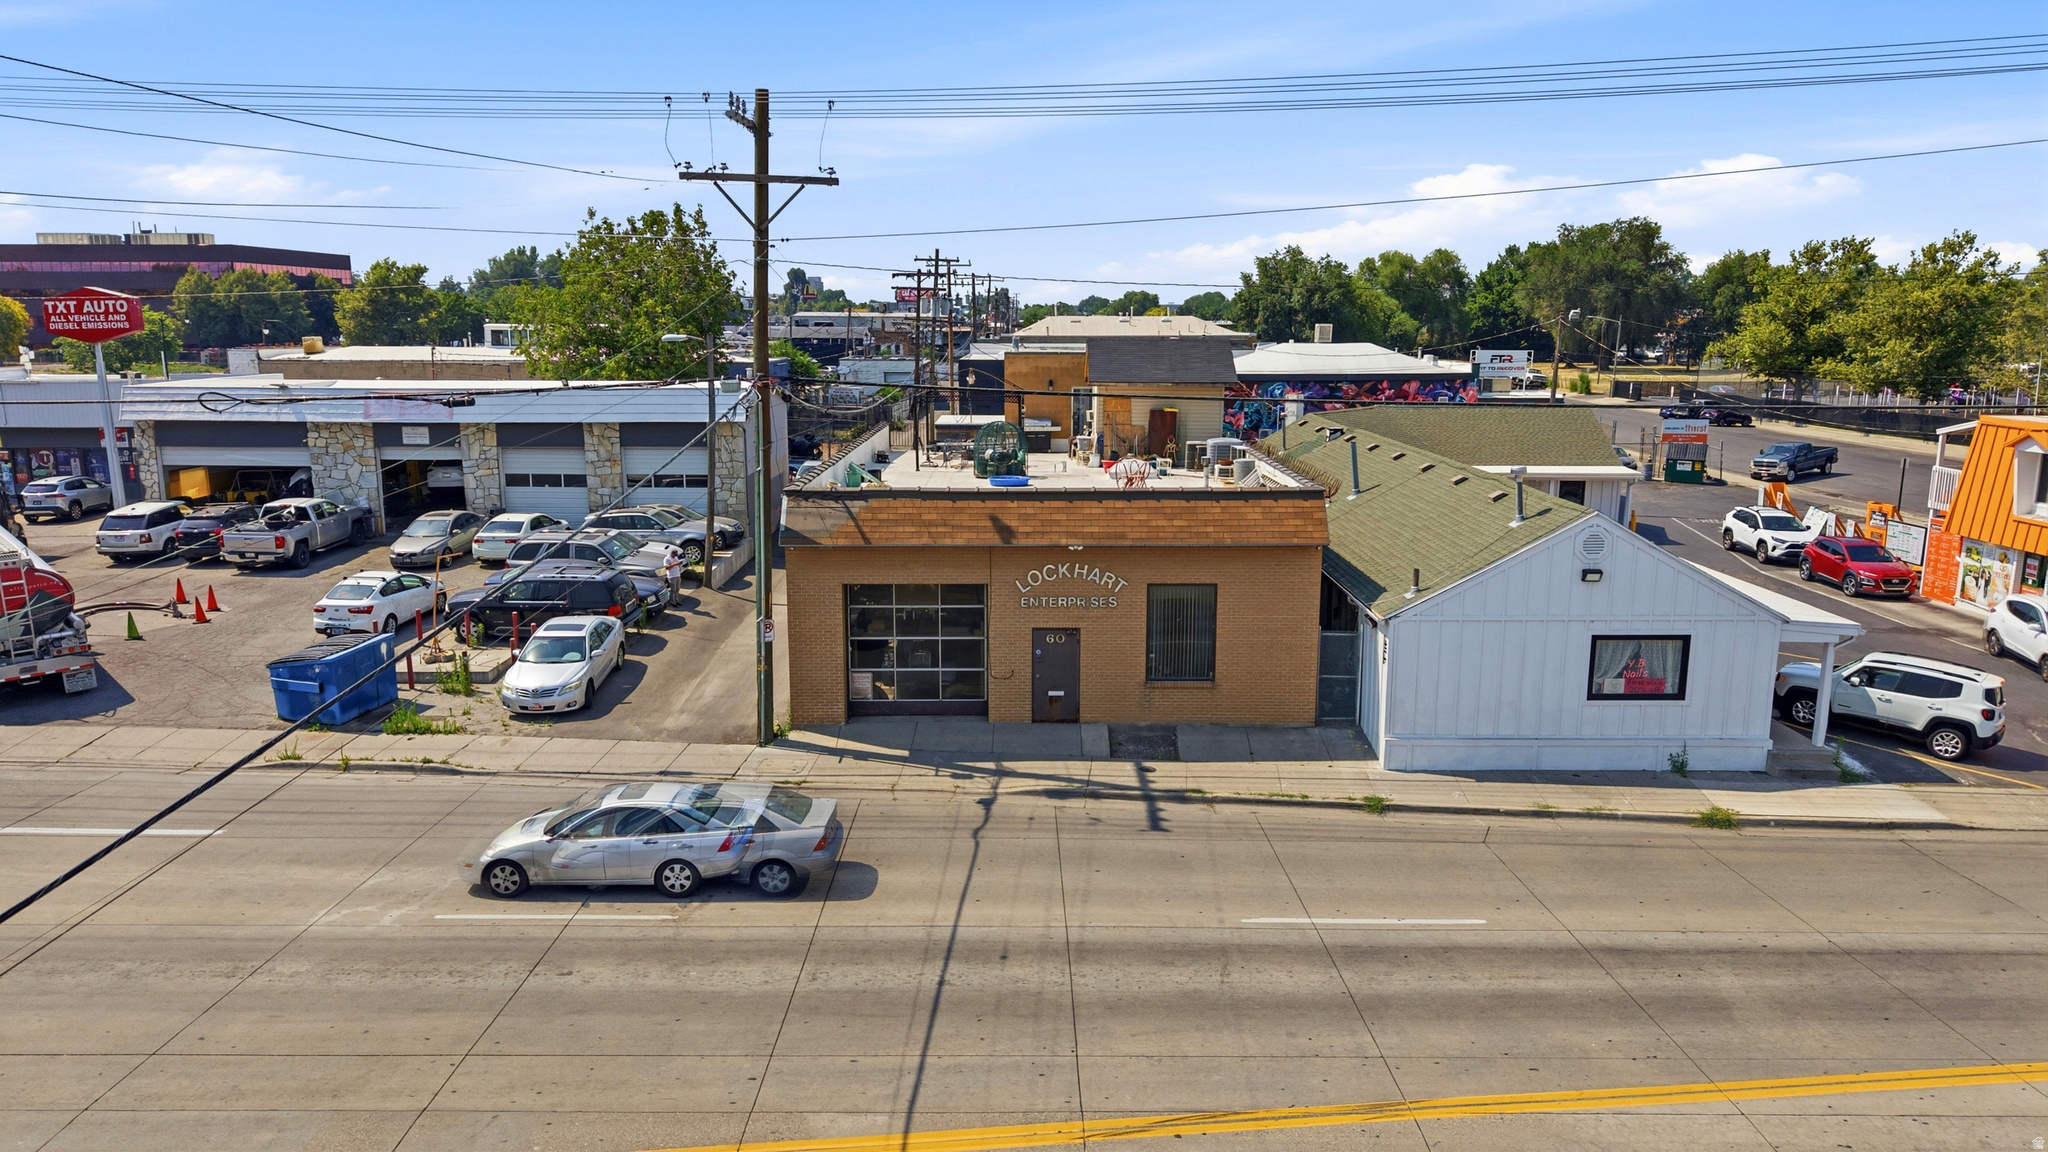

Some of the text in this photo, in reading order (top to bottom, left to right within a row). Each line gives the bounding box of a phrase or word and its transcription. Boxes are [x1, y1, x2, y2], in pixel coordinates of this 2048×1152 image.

[44, 300, 128, 313] TXT AUTO
[68, 314, 105, 322] VEHICLE
[82, 321, 129, 329] EMISSIONS
[1490, 354, 1514, 364] FTR
[1015, 562, 1128, 593] LOCKHART
[1046, 634, 1065, 644] 60
[1622, 668, 1648, 678] Nails
